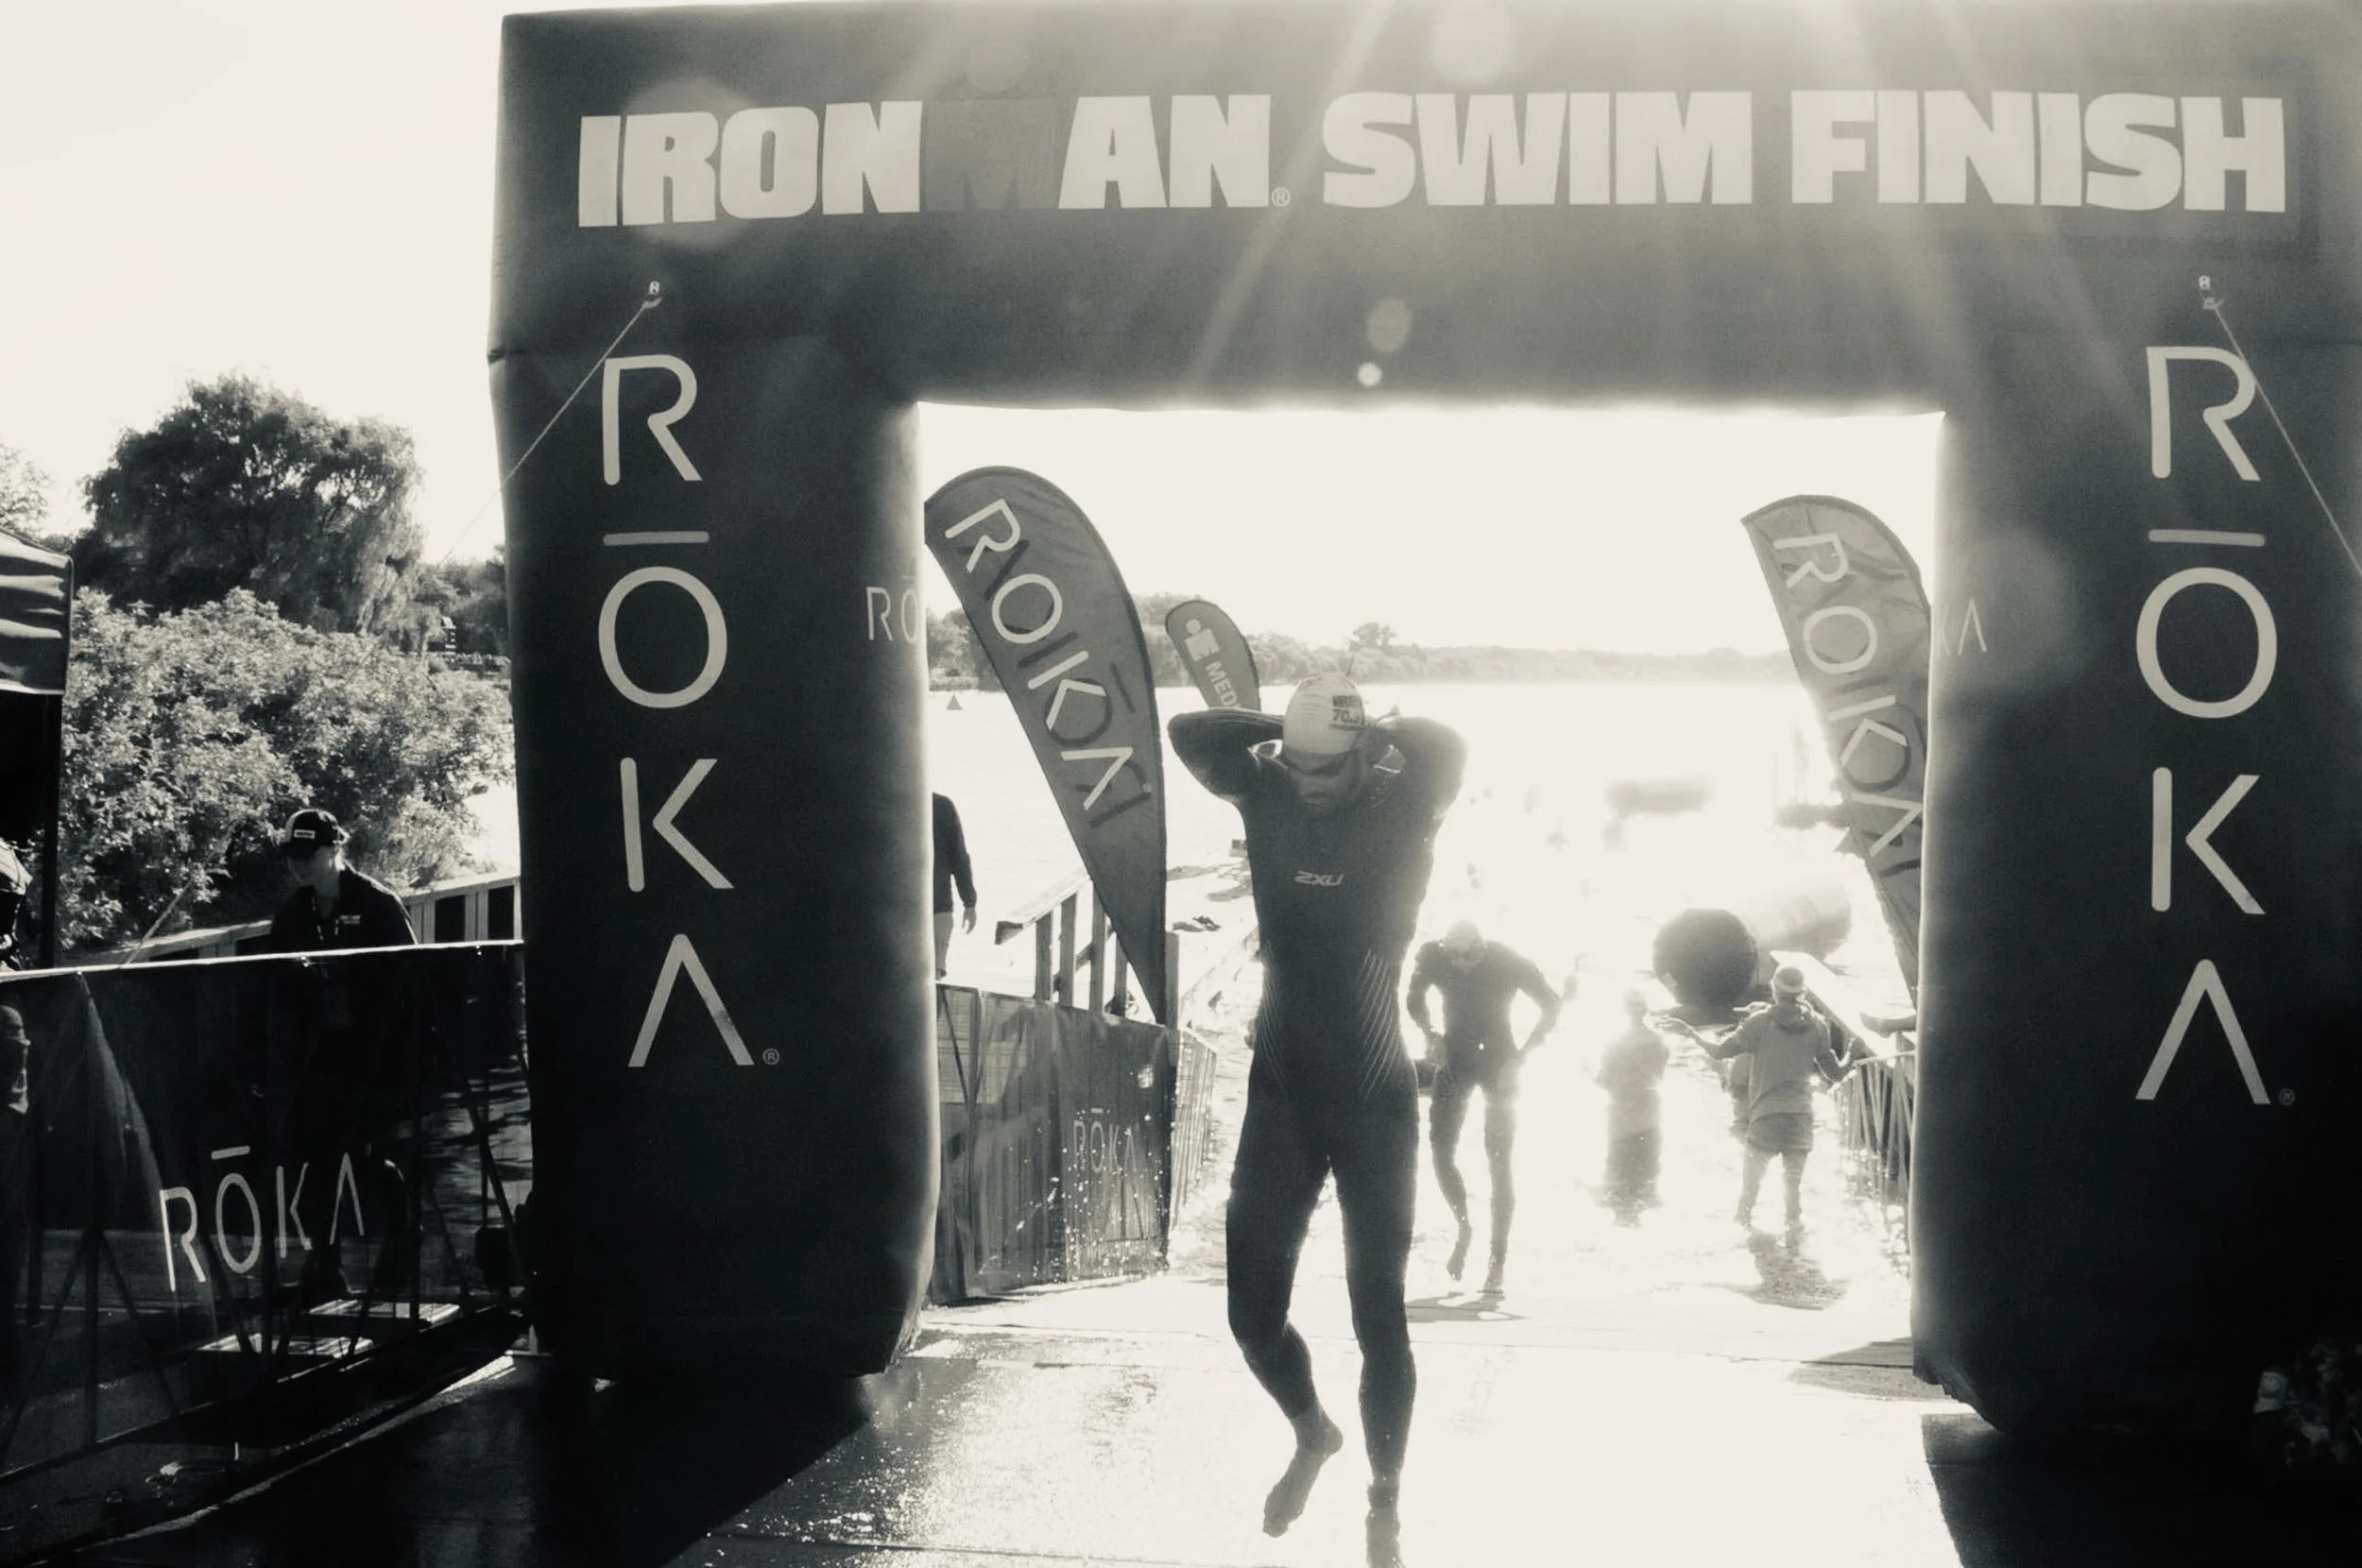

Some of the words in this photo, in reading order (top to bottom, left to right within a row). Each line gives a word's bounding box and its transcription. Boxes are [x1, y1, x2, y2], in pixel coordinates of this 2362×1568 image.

[1323, 91, 1753, 208] SWIM
[1790, 90, 2286, 213] FINISH
[1205, 660, 1241, 708] MED
[1294, 870, 1345, 886] 2XU
